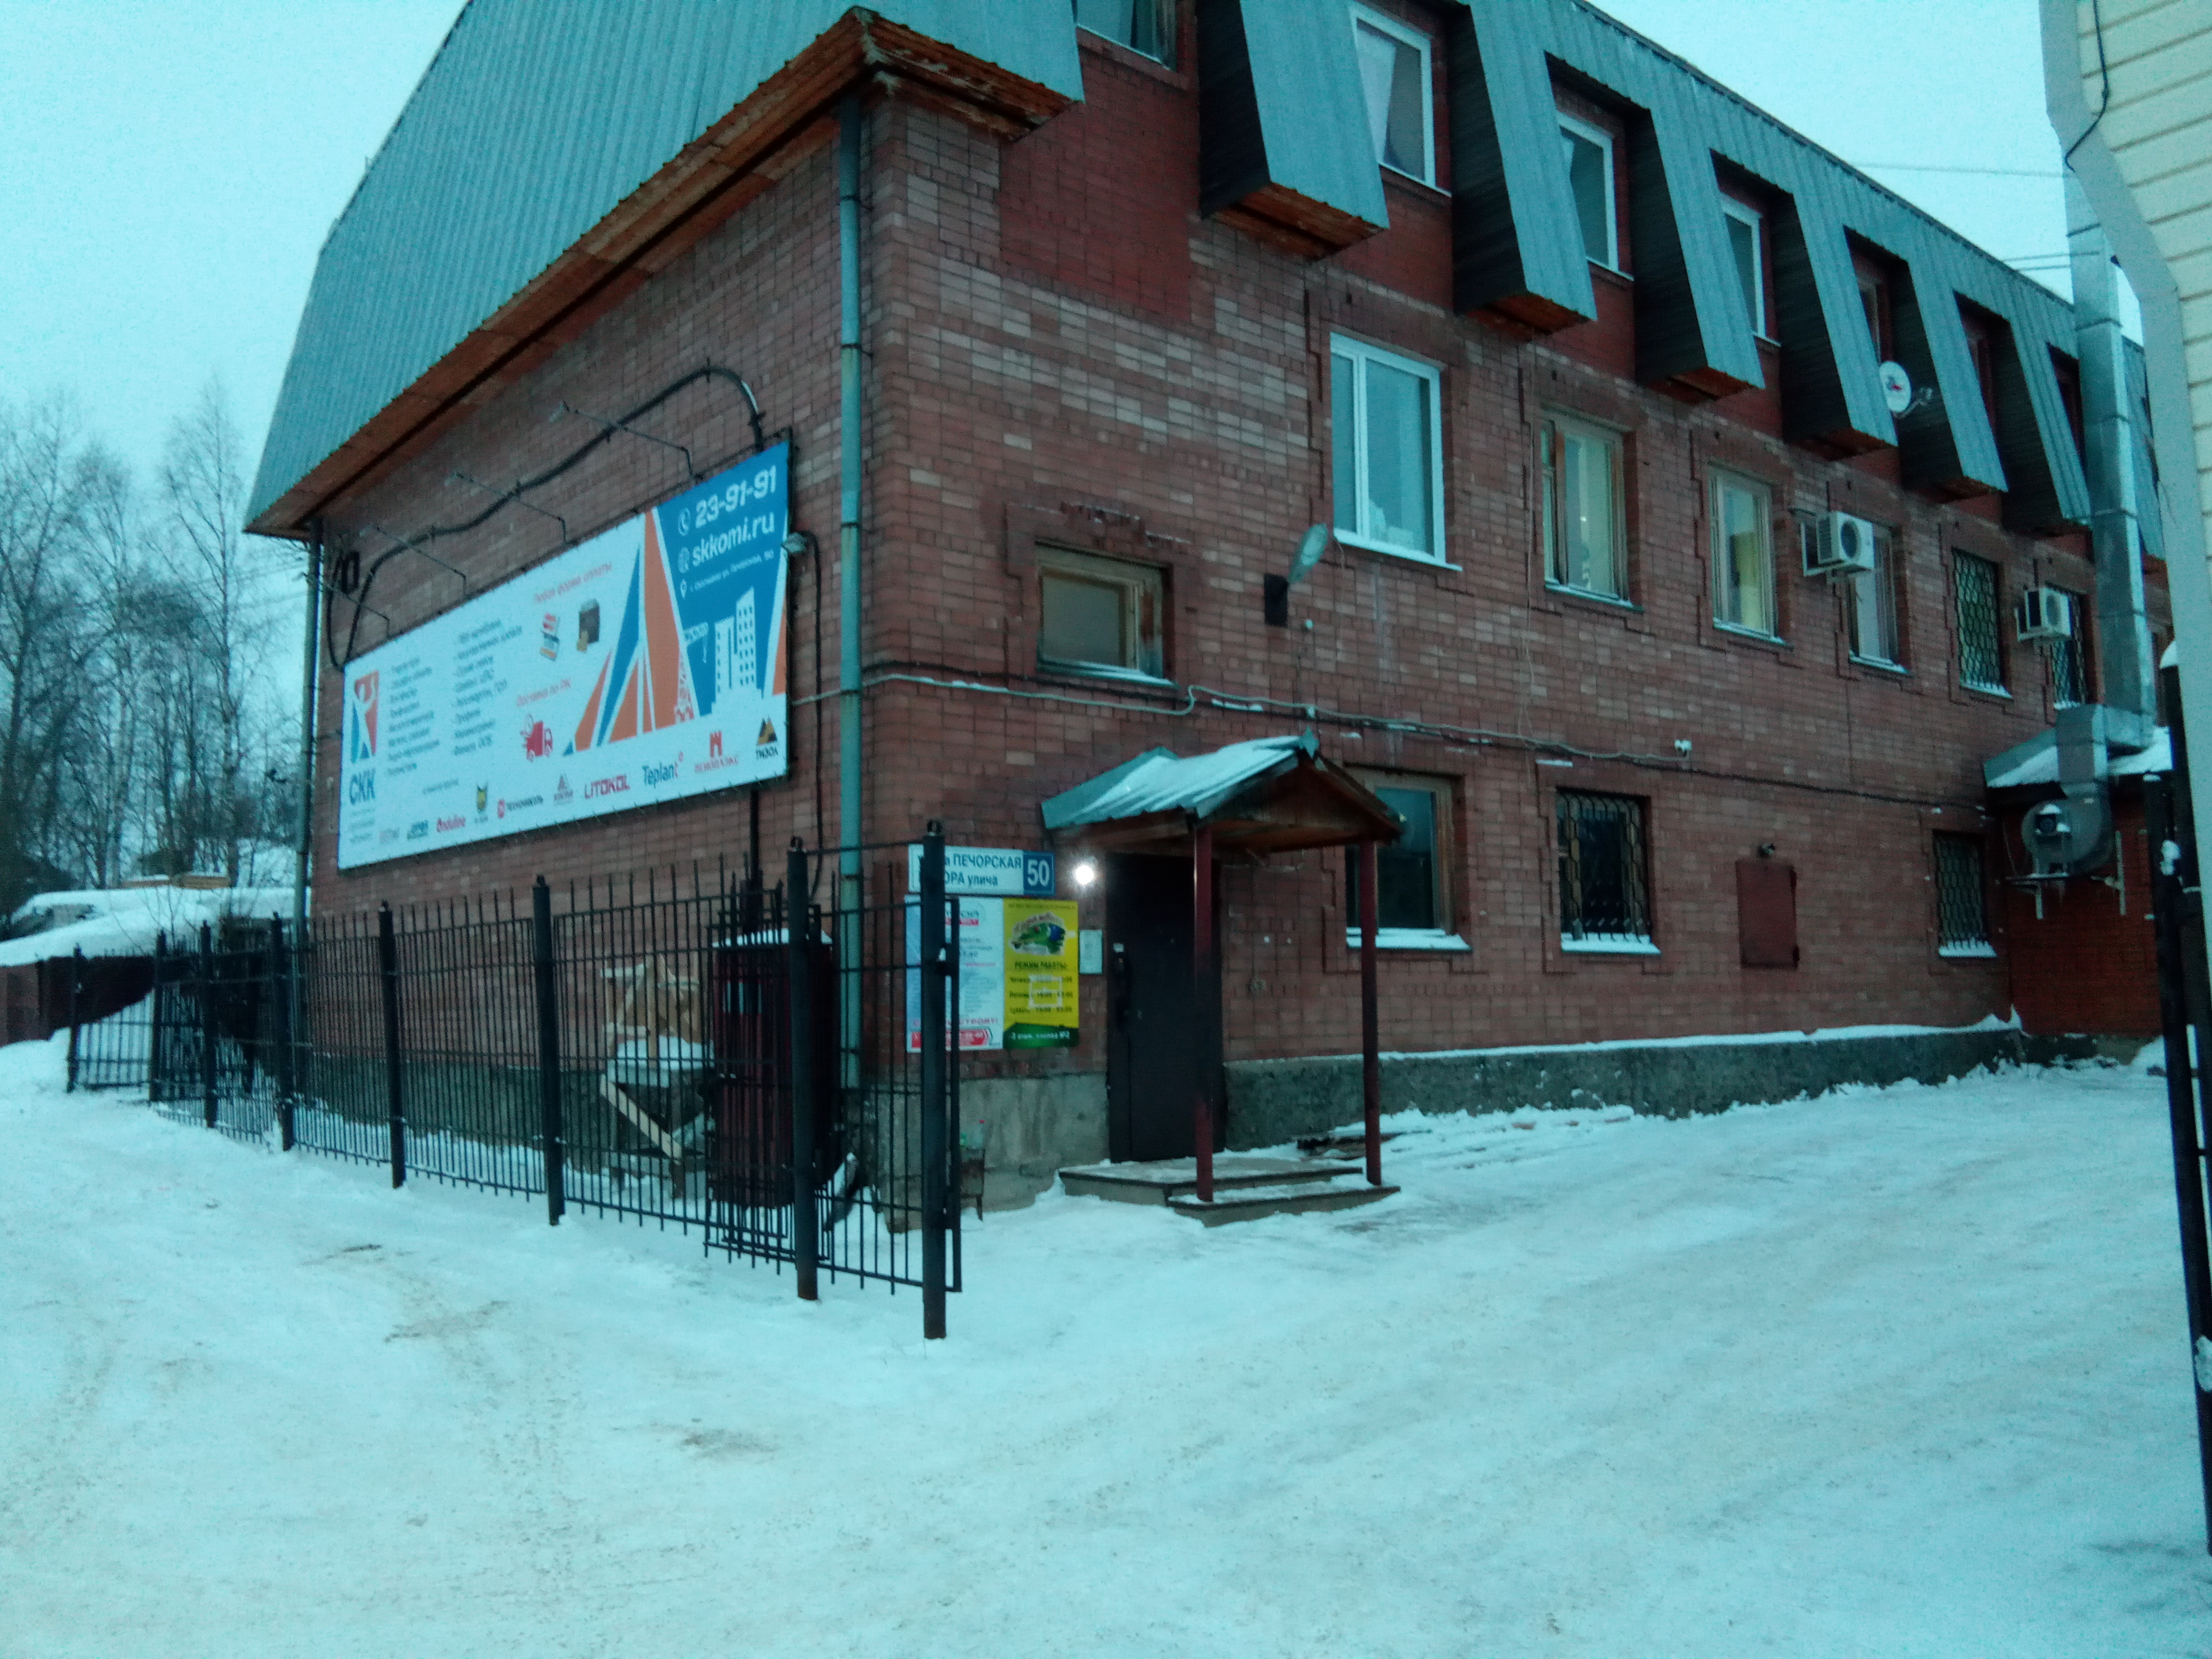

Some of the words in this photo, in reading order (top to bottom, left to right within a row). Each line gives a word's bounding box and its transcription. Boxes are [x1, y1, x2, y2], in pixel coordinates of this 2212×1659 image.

[695, 464, 776, 529] 23-91-91
[692, 512, 775, 567] skkomi.ru
[584, 774, 630, 799] LITOKOL
[642, 761, 678, 789] Teplant
[953, 852, 1022, 869] ПЕЧОРСКАЯ
[1027, 859, 1050, 887] 50
[968, 874, 998, 887] улича
